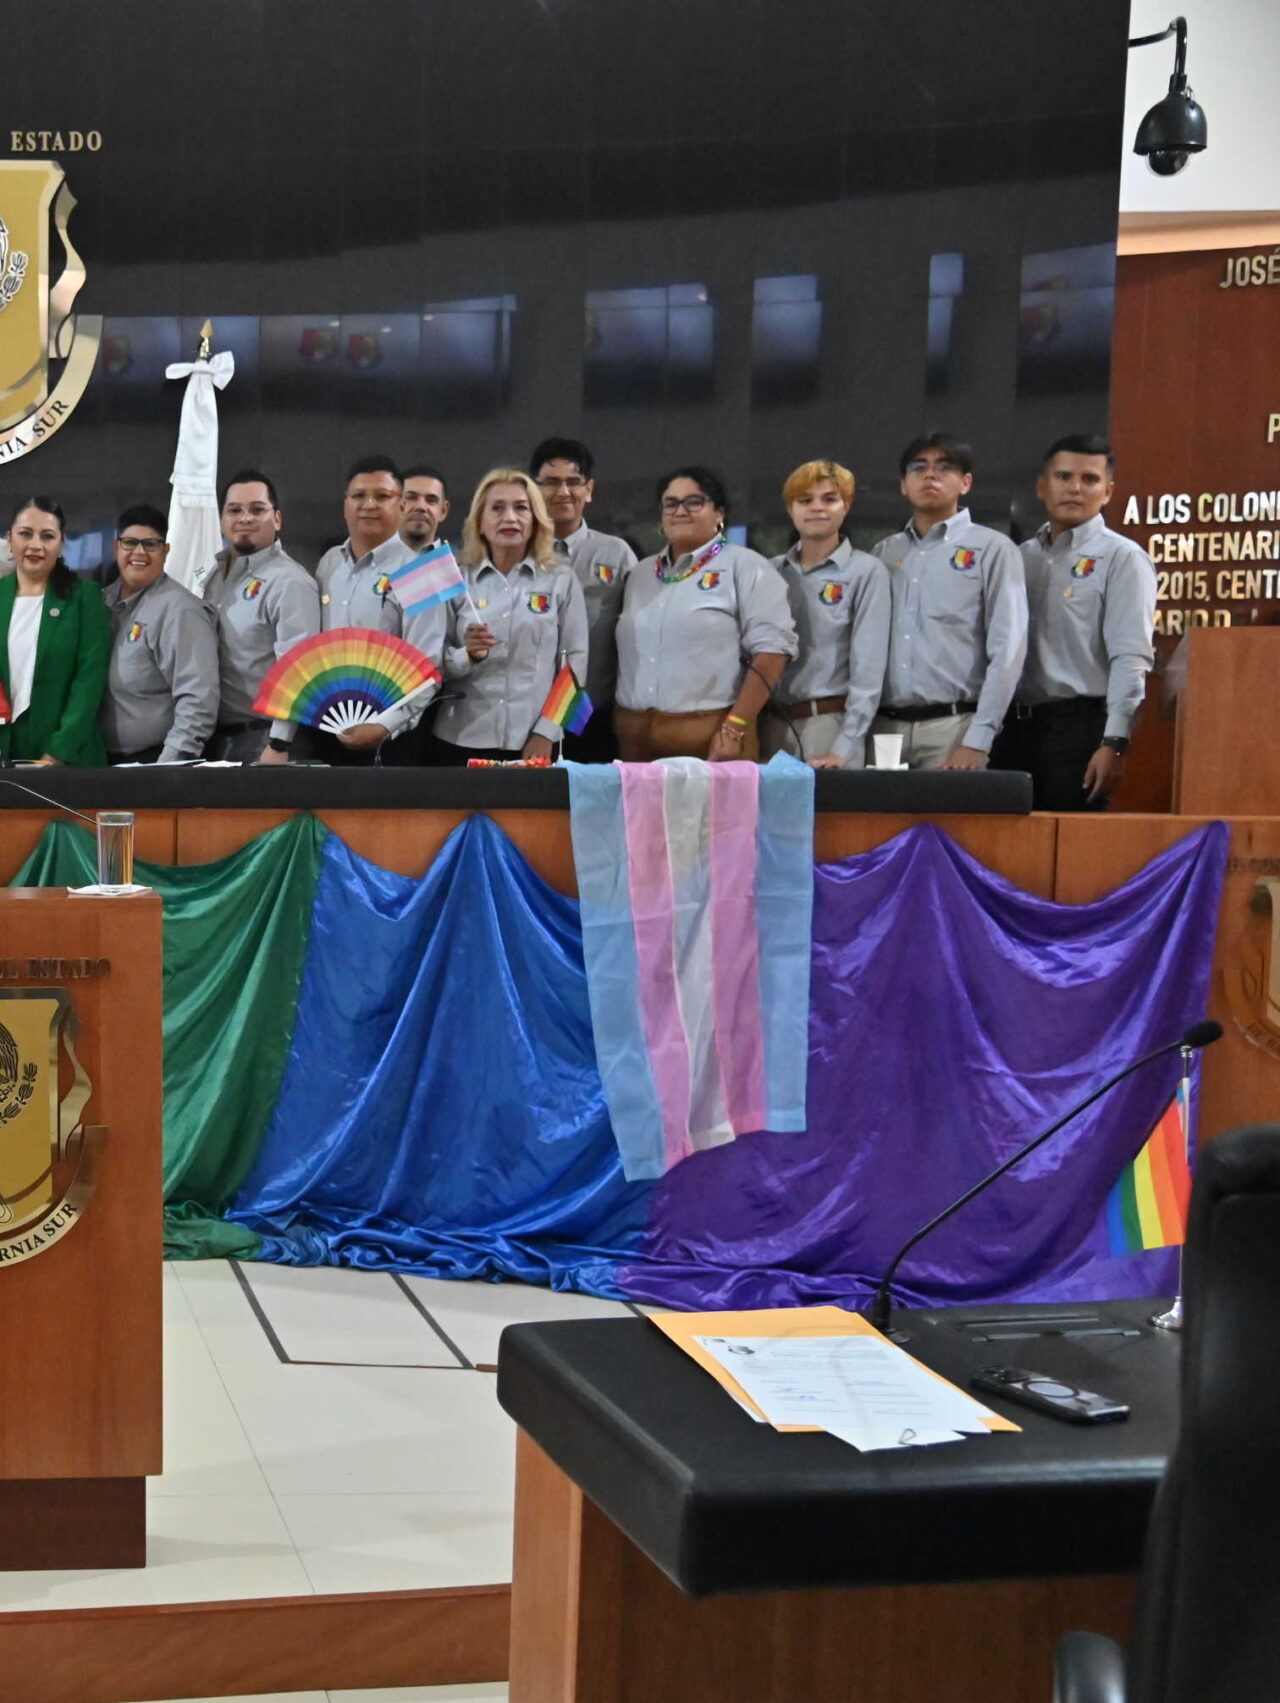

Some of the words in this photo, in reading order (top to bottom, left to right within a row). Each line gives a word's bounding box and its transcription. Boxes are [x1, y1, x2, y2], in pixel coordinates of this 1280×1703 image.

[10, 130, 102, 151] ESTADO
[32, 399, 69, 438] SUR
[1122, 495, 1140, 525] A
[1146, 493, 1191, 524] LOS
[1156, 571, 1211, 602] 2015,
[43, 1202, 78, 1238] SUR
